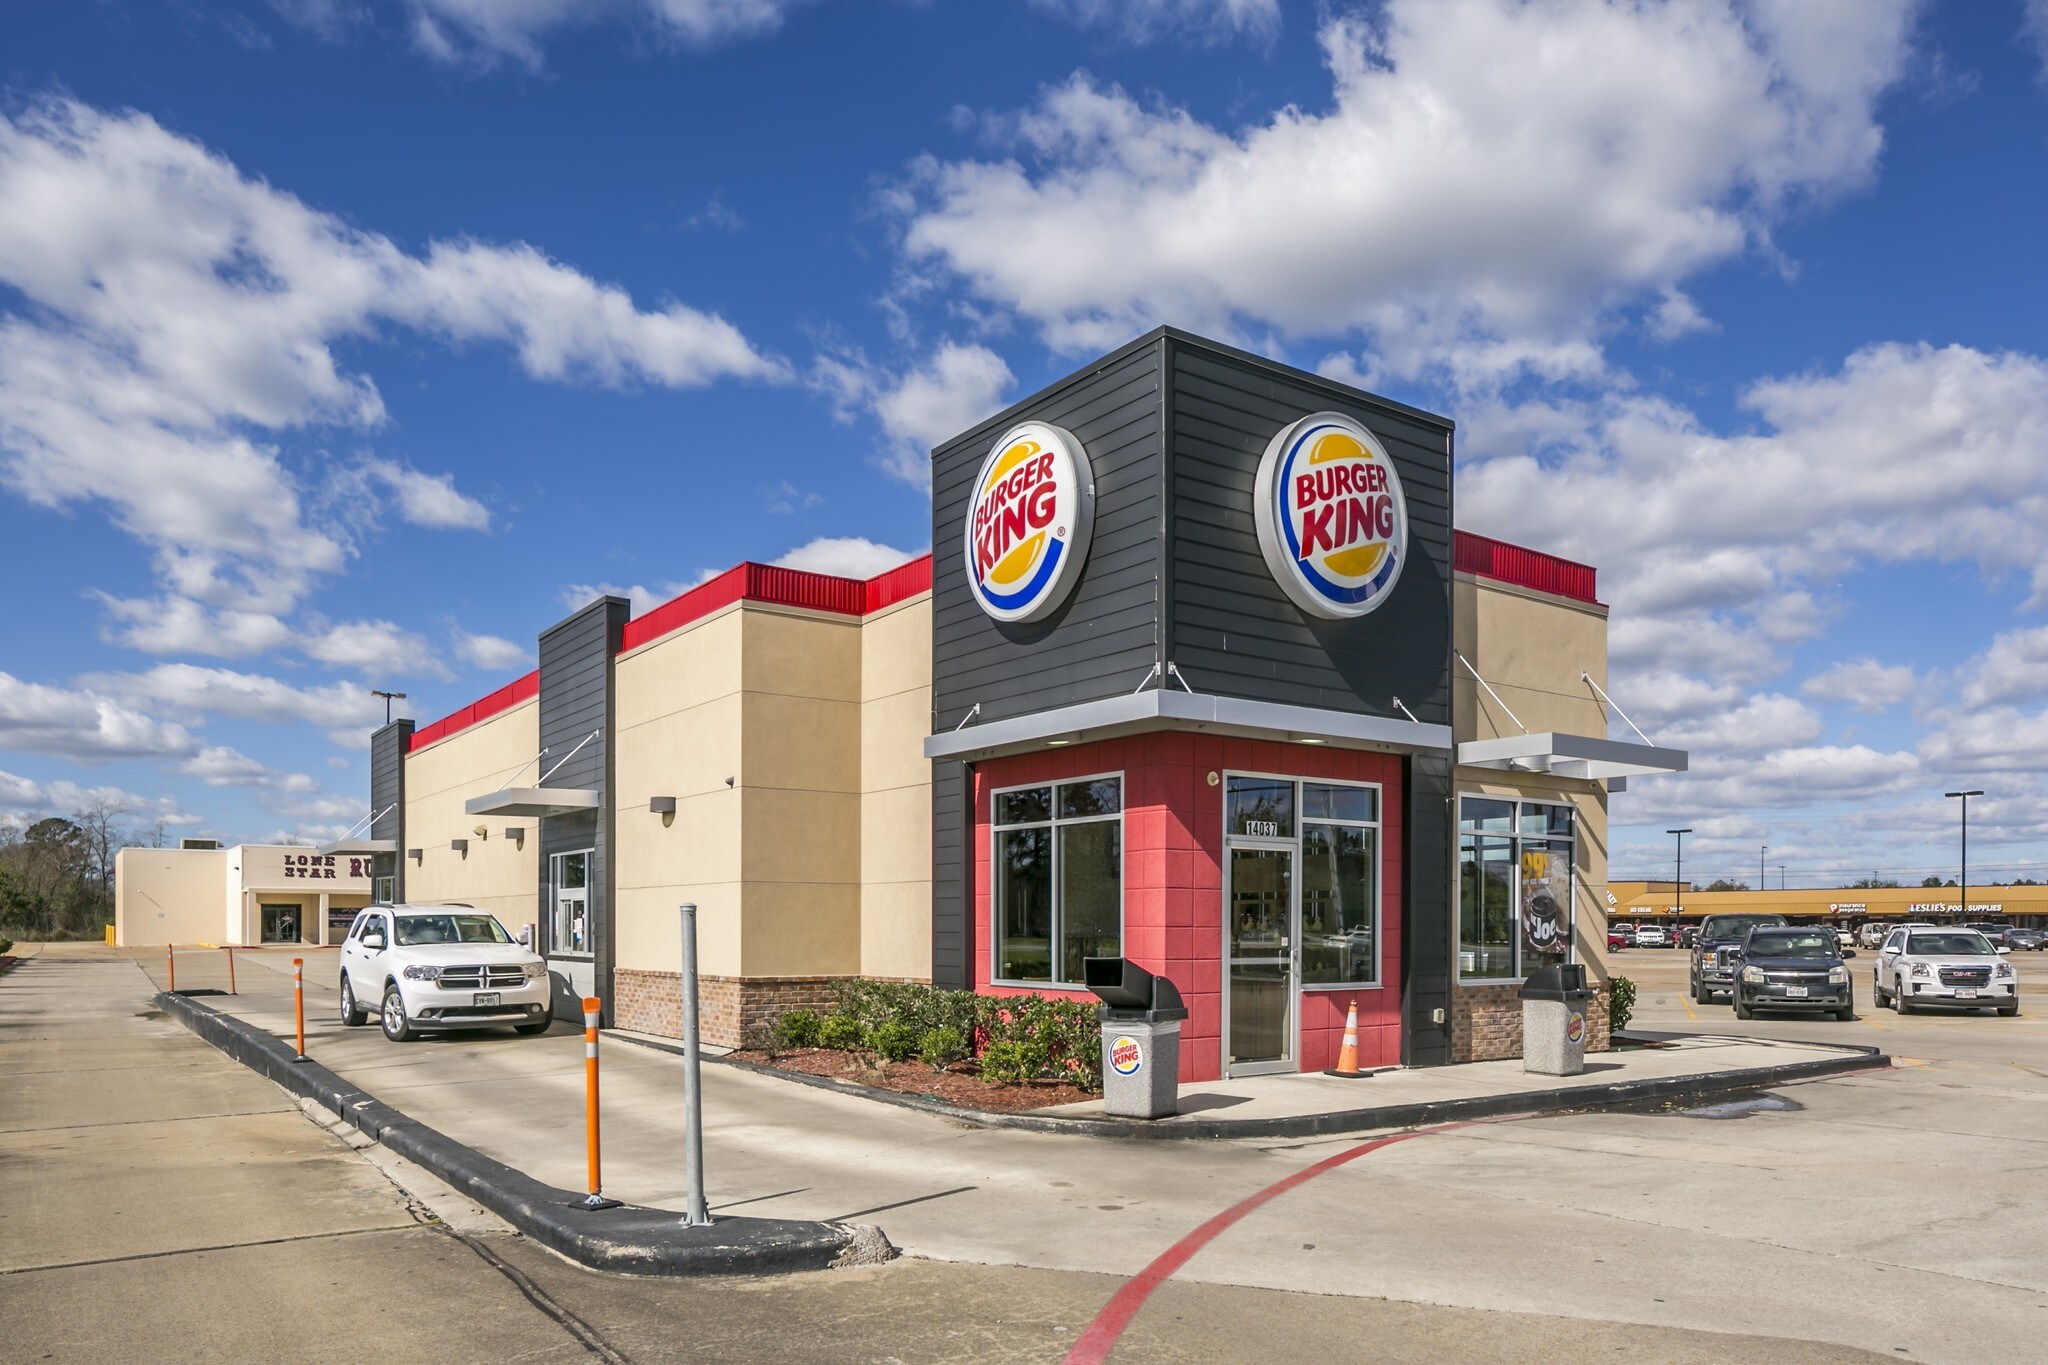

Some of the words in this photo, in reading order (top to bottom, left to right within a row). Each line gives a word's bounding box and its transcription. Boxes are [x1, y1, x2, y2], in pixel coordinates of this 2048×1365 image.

[1296, 463, 1389, 510] BURGER
[976, 452, 1054, 541] BURGER
[977, 481, 1057, 583] KING
[1300, 494, 1393, 559] KING
[1248, 822, 1276, 836] 14037
[284, 855, 336, 866] LONE
[285, 867, 336, 879] STAR
[1607, 890, 1617, 905] KET
[1910, 903, 1946, 912] LESLIE'S
[1968, 904, 2002, 912] SUPPLIES
[1113, 1044, 1137, 1056] BURGER
[1114, 1051, 1138, 1066] KING
